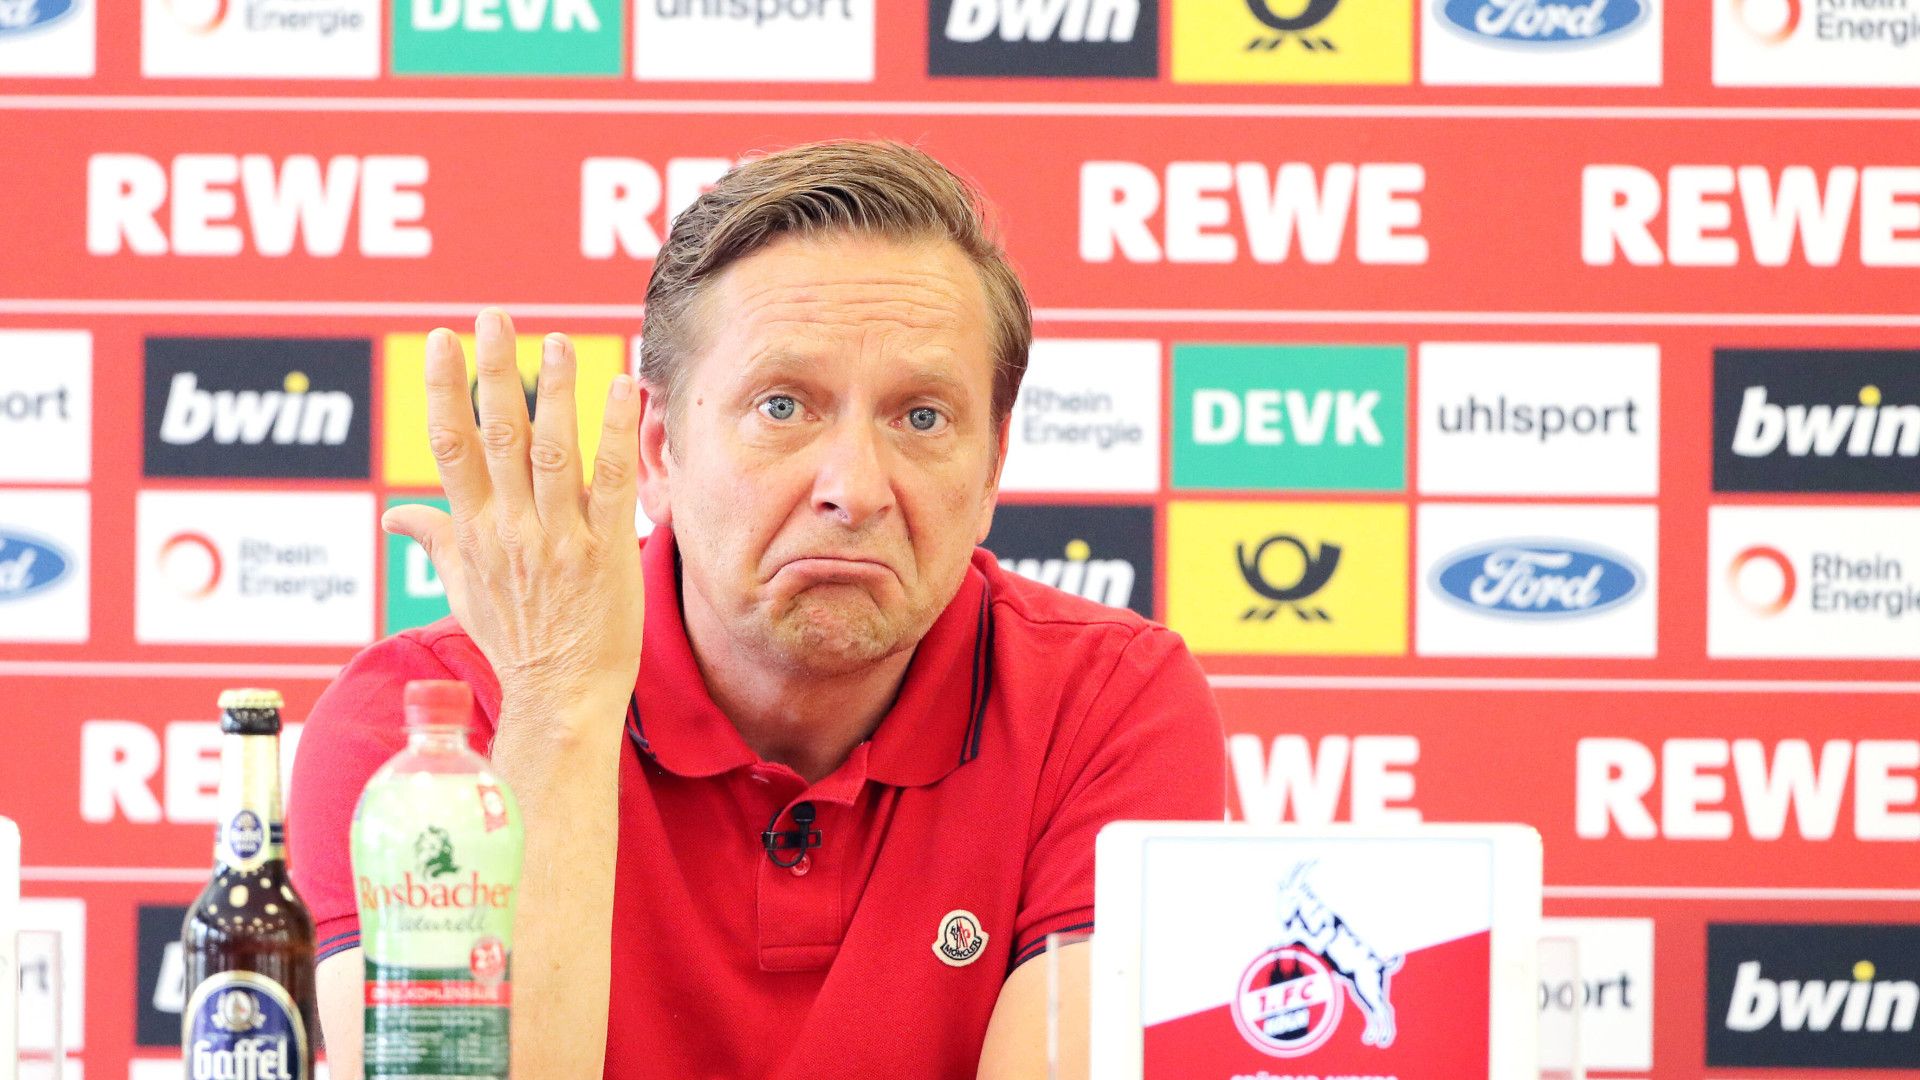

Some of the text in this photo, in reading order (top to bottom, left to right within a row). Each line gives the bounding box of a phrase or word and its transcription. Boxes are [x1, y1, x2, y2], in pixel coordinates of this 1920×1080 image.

[412, 0, 600, 31] DEVK
[946, 0, 1139, 42] bwin
[1474, 0, 1606, 36] Ford
[1816, 13, 1920, 46] Energi
[87, 154, 432, 257] REWE
[1080, 161, 1429, 263] REWE
[1581, 165, 1920, 266] REWE
[160, 372, 353, 444] bwin
[1023, 387, 1112, 412] Rhein
[1192, 389, 1383, 446] DEVK
[1438, 396, 1638, 440] uhlsport
[1731, 384, 1920, 456] bwin
[1023, 418, 1142, 451] Energie
[239, 538, 327, 564] Rhein
[1811, 554, 1902, 582] Rhein
[239, 568, 358, 601] Energie
[1468, 549, 1603, 608] Ford
[1811, 585, 1920, 617] Energi
[1229, 734, 1420, 822] WE
[1575, 738, 1920, 840] REWE
[359, 871, 513, 910] Rosbacher
[945, 937, 981, 957] MONCLER
[1726, 961, 1918, 1031] bwin
[192, 1037, 292, 1080] Gaffel
